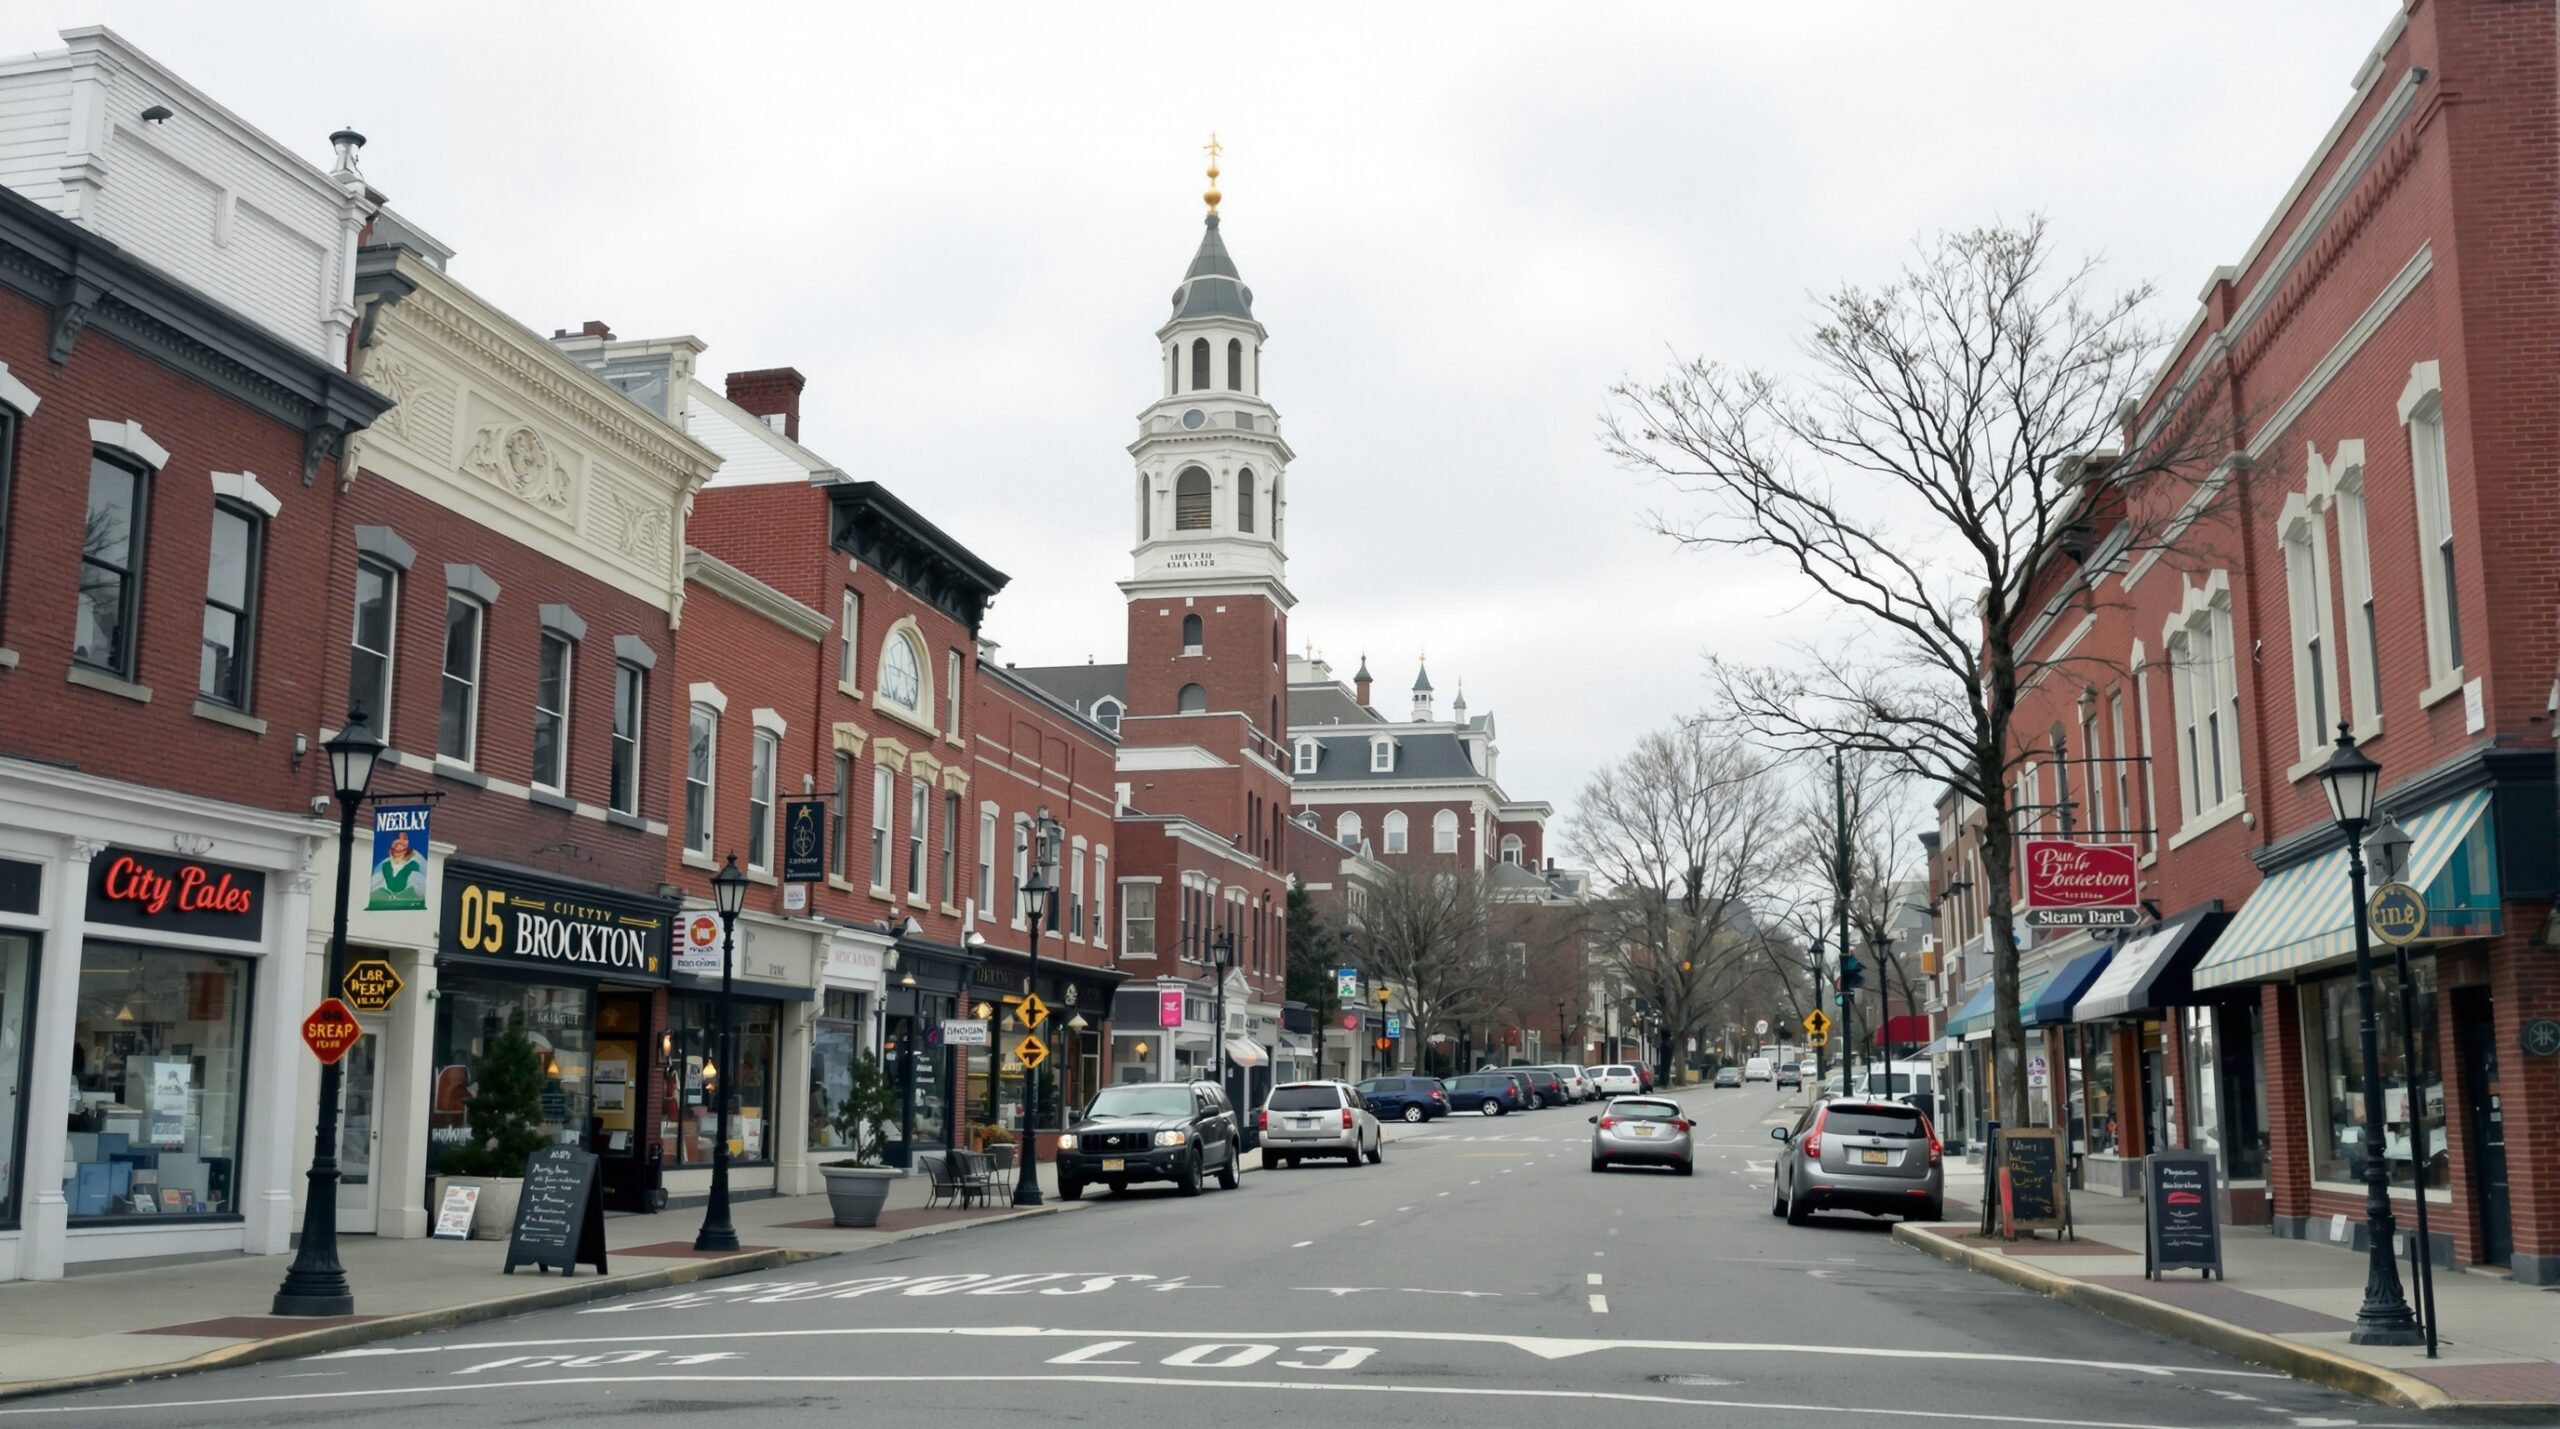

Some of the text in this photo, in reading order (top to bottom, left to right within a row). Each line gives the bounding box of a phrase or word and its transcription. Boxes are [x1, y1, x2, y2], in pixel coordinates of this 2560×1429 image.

[106, 857, 252, 915] City Pales
[460, 885, 505, 953] 05
[515, 912, 646, 969] BROCKTON
[308, 1023, 354, 1038] SREAP
